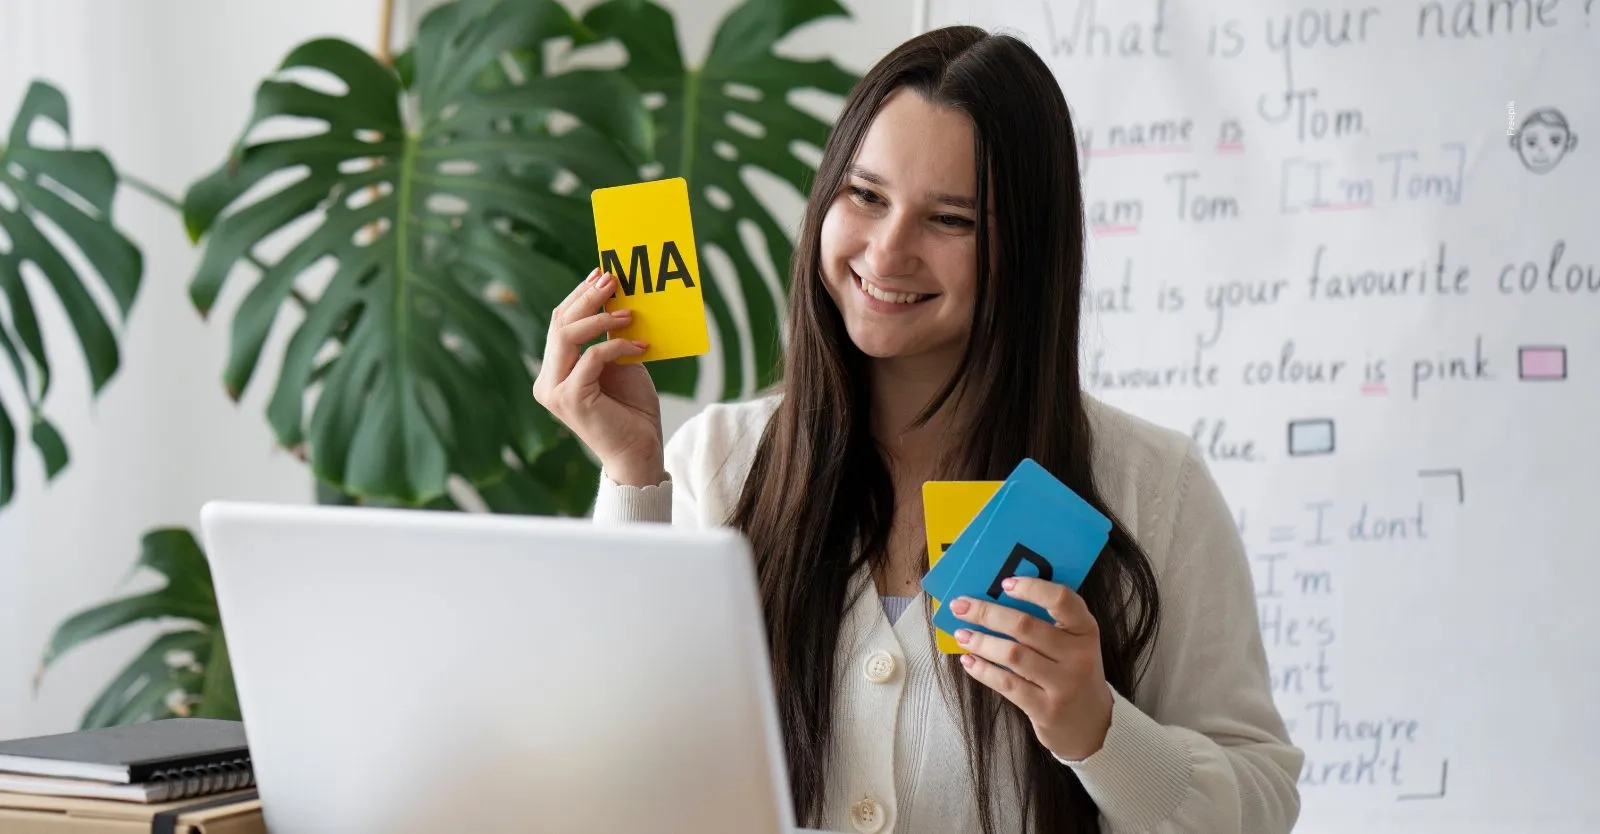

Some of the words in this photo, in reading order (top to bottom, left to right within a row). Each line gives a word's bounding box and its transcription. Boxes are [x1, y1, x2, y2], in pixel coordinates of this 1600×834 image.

[1042, 0, 1174, 58] What
[1207, 16, 1246, 59] is
[1257, 6, 1382, 123] your
[1416, 0, 1560, 40] name
[1107, 115, 1195, 148] name
[601, 240, 696, 299] MA
[1157, 281, 1187, 313] is
[1196, 278, 1289, 348] your
[1309, 241, 1471, 299] favourite
[1088, 348, 1219, 390] favourite
[1243, 338, 1346, 387] colour
[1363, 350, 1387, 383] is
[1303, 499, 1334, 548] I
[1256, 551, 1334, 599] I'm
[1260, 602, 1336, 649] He's
[1303, 698, 1420, 768] They're
[1299, 746, 1404, 787] aren't
